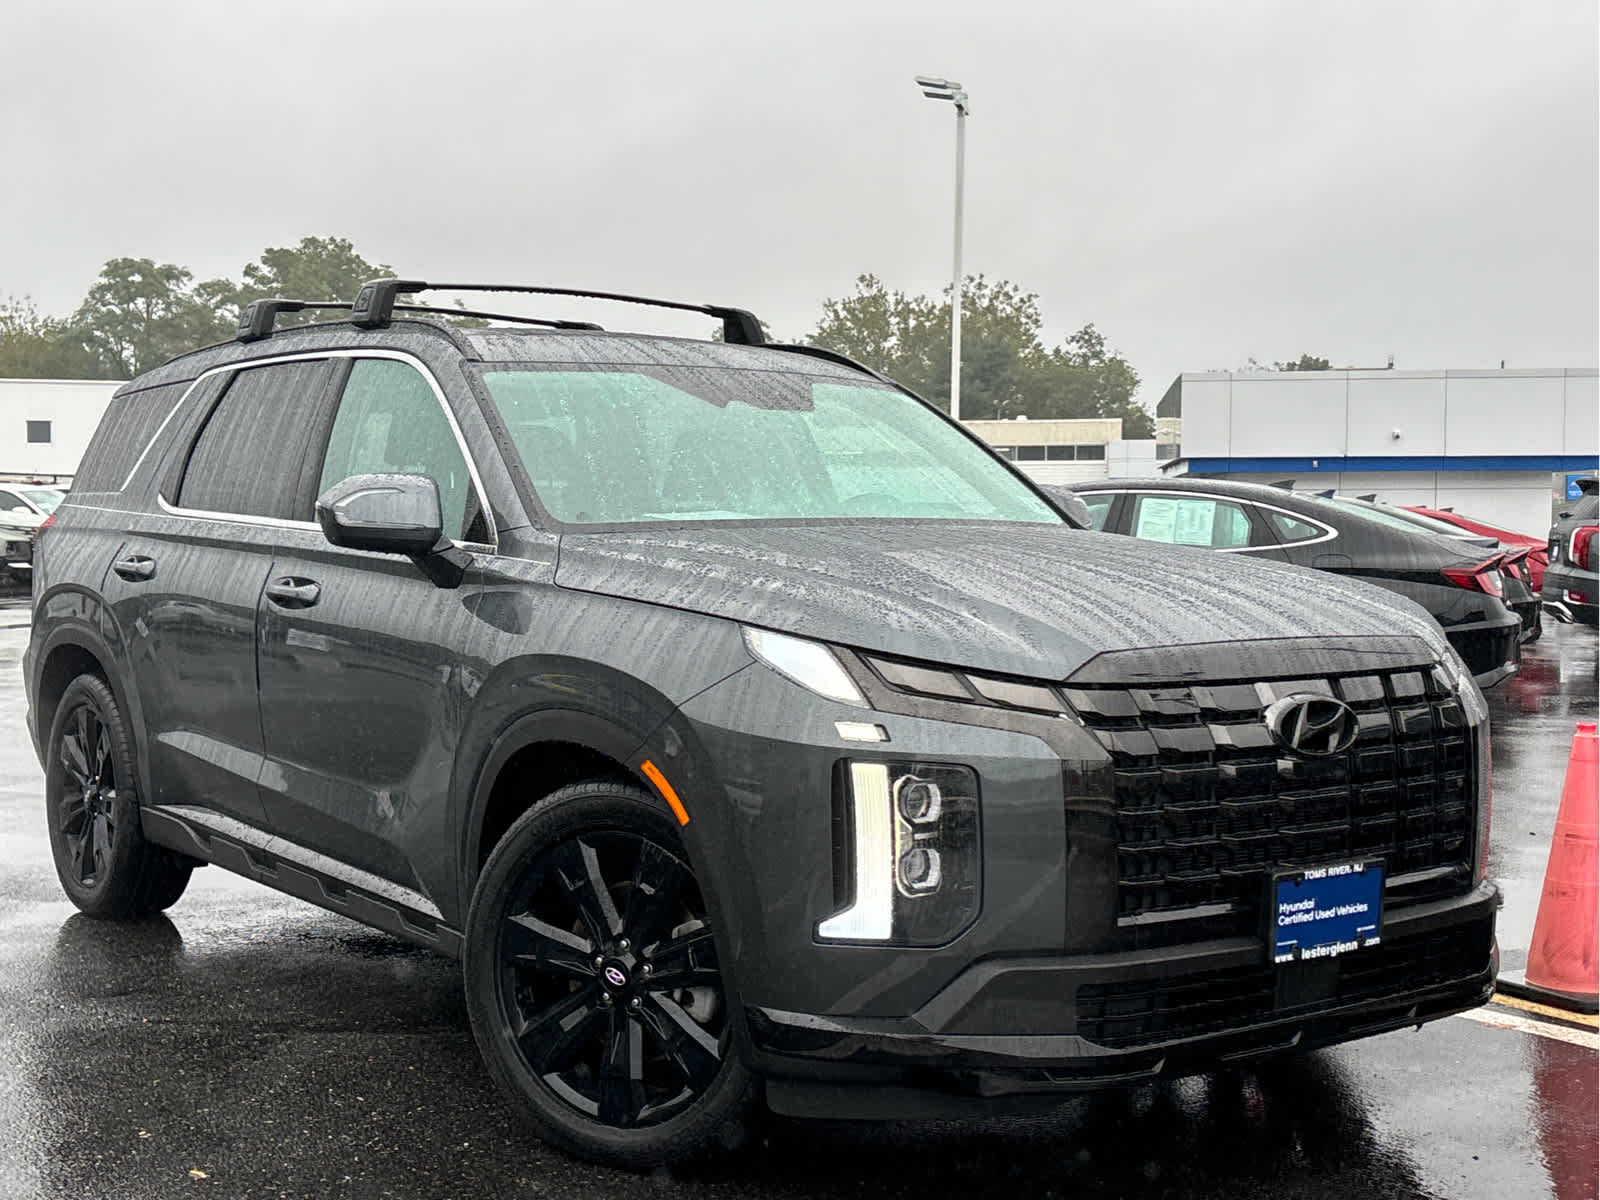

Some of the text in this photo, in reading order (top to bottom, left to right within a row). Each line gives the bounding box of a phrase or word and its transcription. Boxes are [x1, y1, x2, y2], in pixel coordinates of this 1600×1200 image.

[1304, 868, 1327, 880] TOMS
[1353, 862, 1364, 872] NJ
[1278, 903, 1368, 926] Certified Used Vehicles
[1279, 898, 1315, 914] Hyundai
[1301, 941, 1358, 960] lesterglenn
